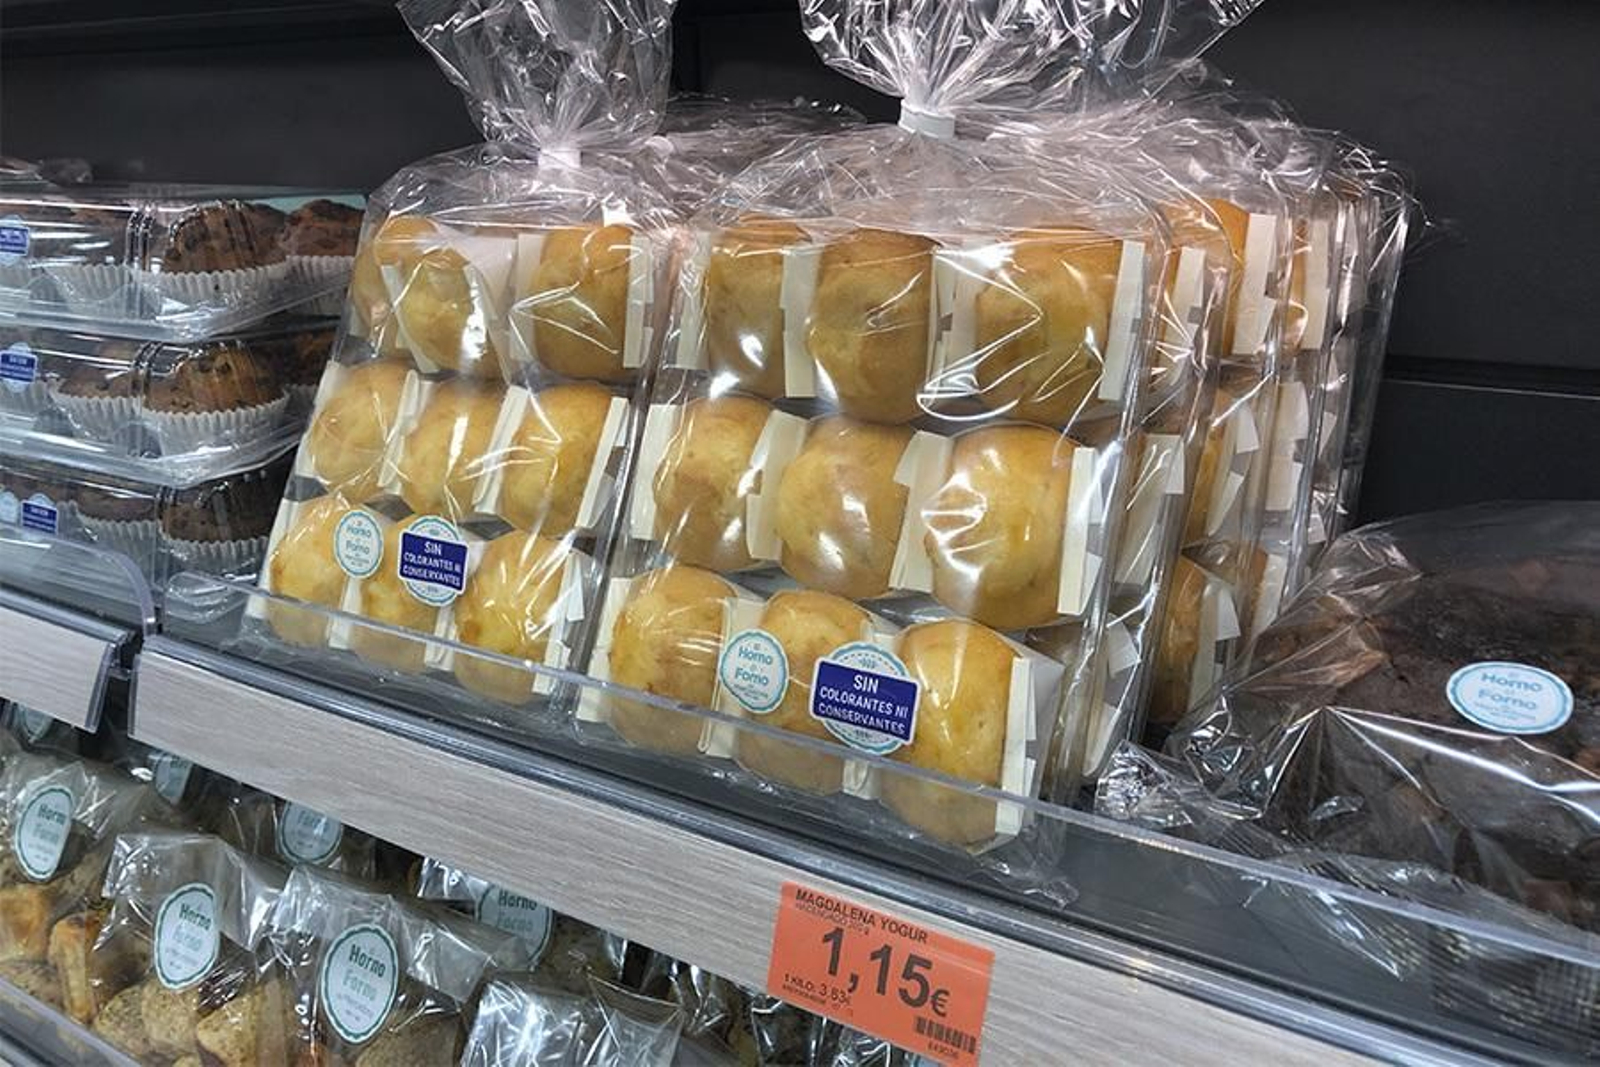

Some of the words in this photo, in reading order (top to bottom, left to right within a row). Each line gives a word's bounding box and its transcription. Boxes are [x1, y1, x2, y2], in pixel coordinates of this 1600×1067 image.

[424, 541, 443, 556] SIN
[403, 551, 453, 571] COLORANTES
[402, 565, 461, 586] CONSERVANTES
[738, 645, 774, 667] Horno
[734, 667, 769, 687] Forno
[853, 674, 880, 693] SIN
[1481, 672, 1543, 693] Horno
[819, 685, 893, 716] COLORANTES
[894, 705, 910, 719] NI
[1478, 688, 1537, 710] Forno
[818, 703, 907, 735] CONSERVANTES
[498, 888, 538, 911] Horno
[179, 903, 212, 930] Horno
[795, 889, 876, 927] MAGDALENA
[880, 916, 928, 943] YOGUR
[349, 944, 386, 978] Horno
[822, 927, 951, 1017] 1,15€
